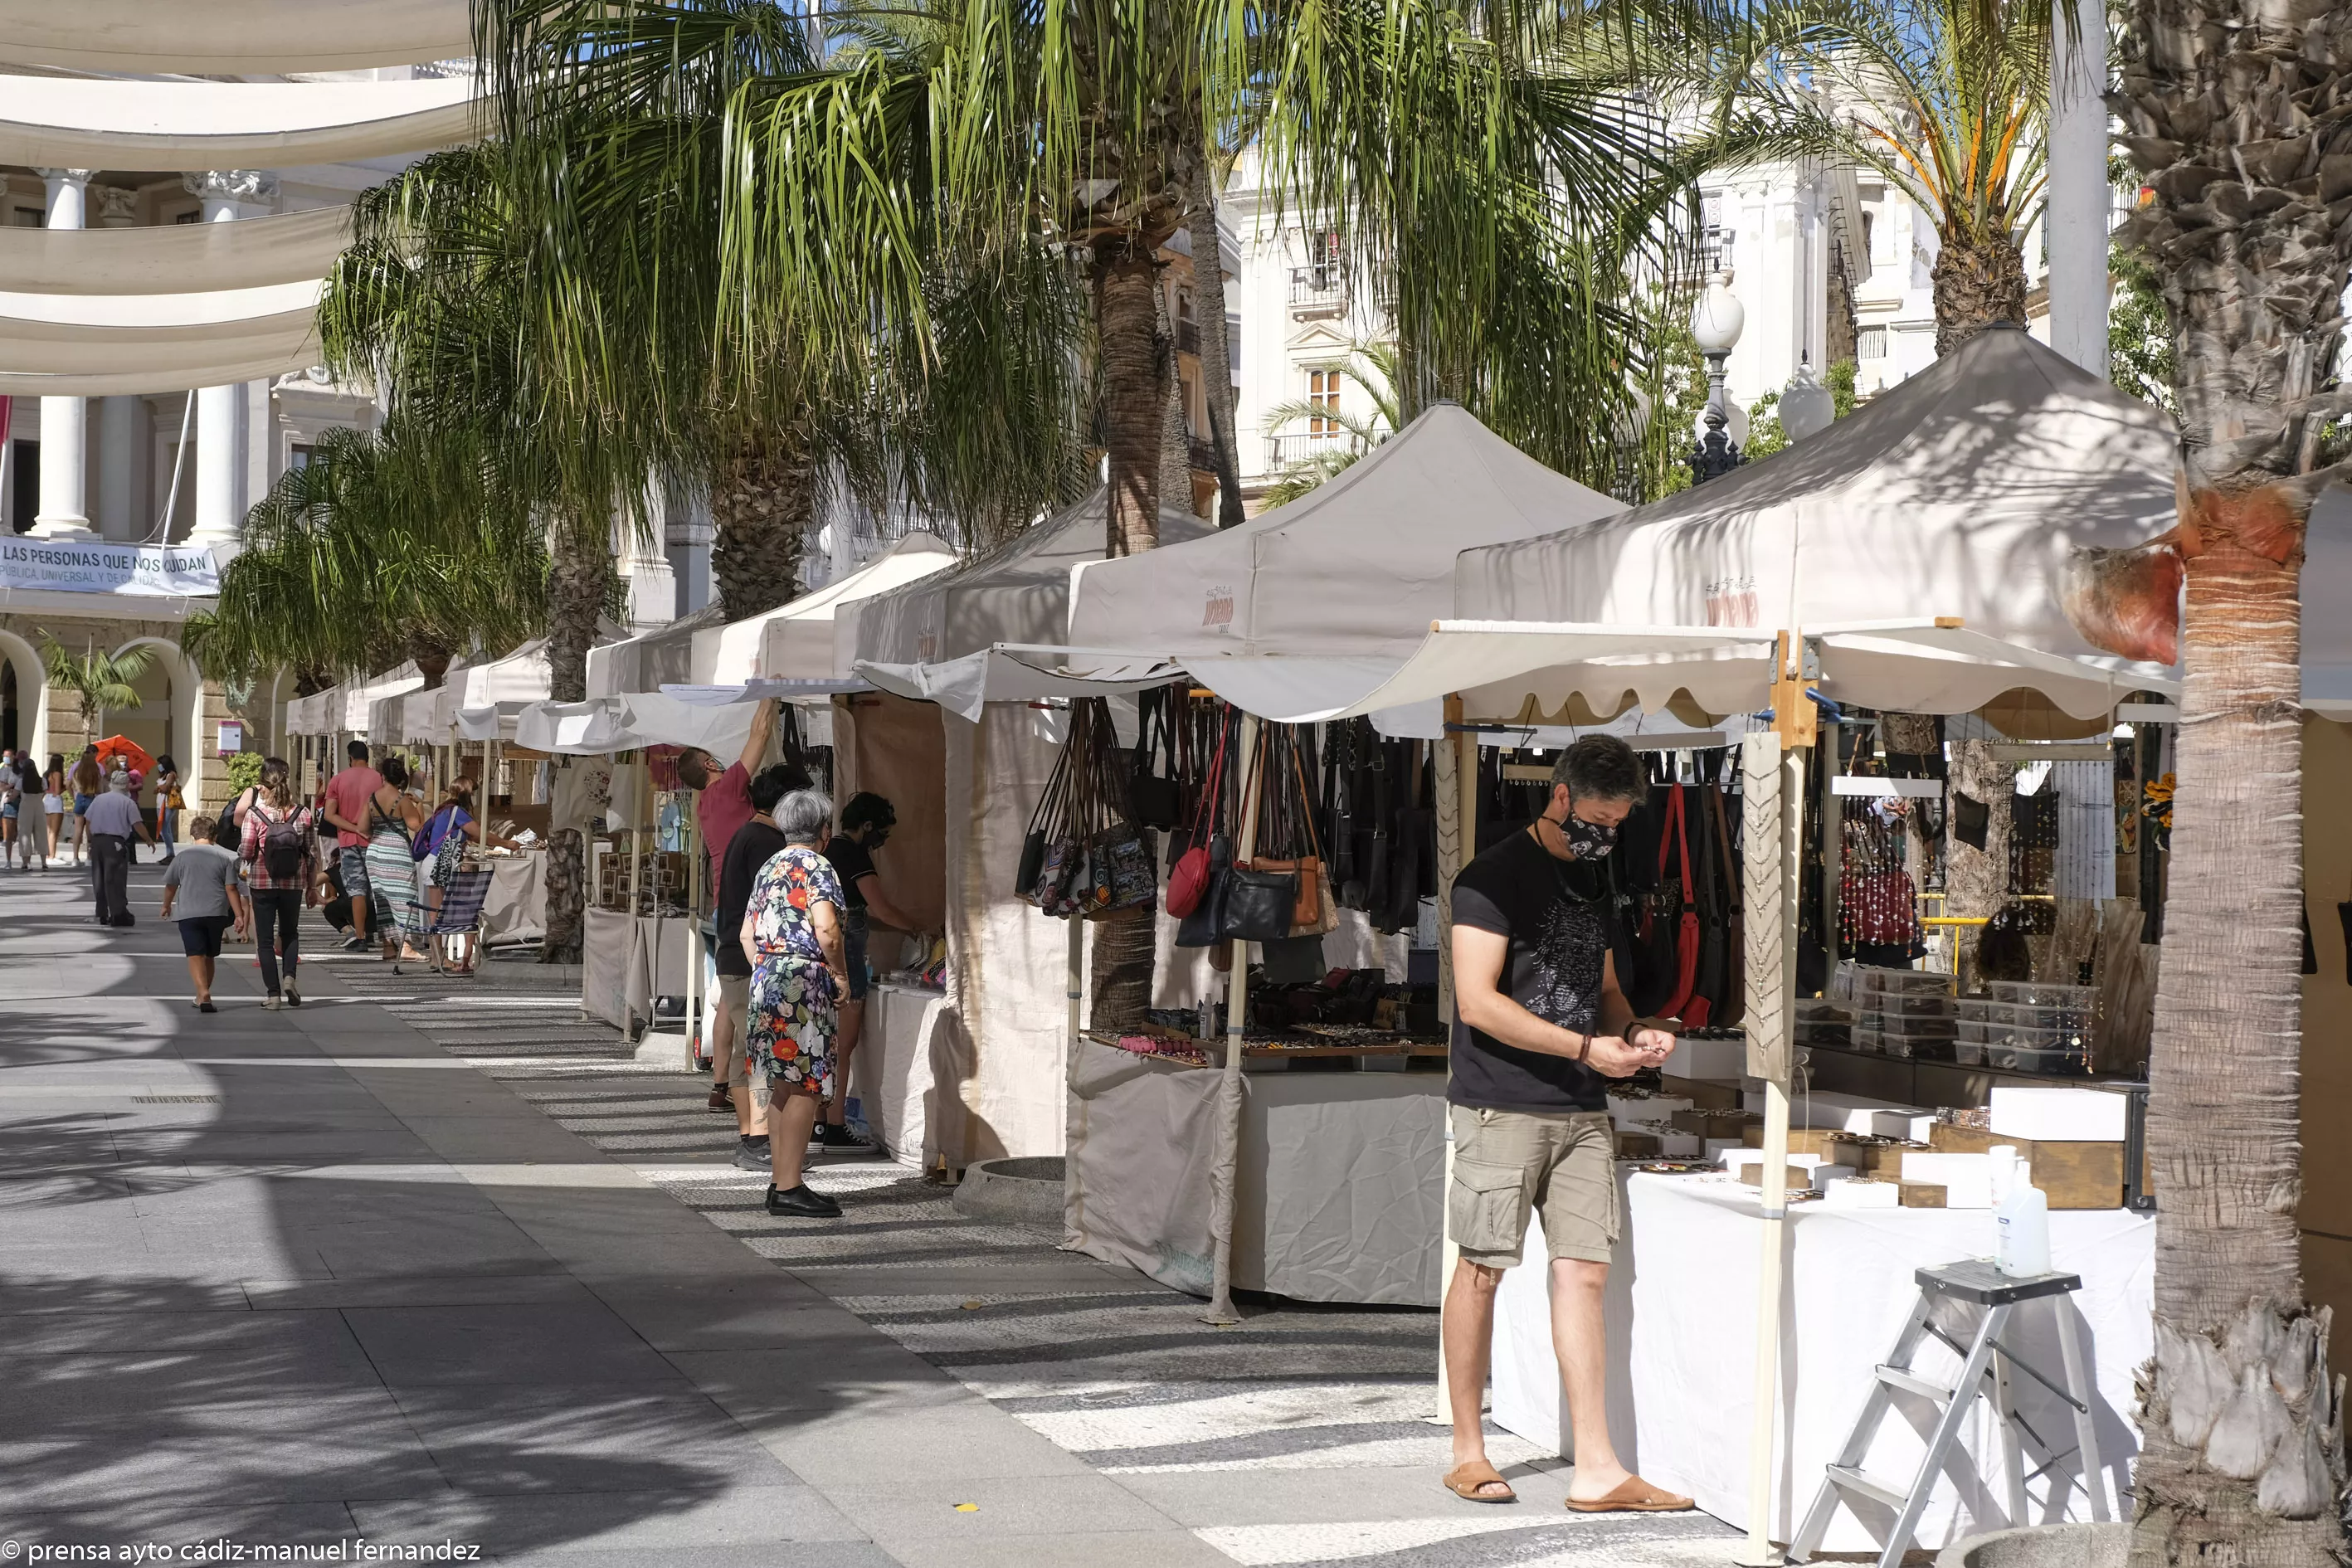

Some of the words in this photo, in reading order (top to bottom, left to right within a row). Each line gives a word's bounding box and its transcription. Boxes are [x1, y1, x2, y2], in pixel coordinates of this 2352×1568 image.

[3, 545, 28, 562] LAS
[30, 548, 100, 567] PERSONAS
[102, 554, 130, 570] QUE
[133, 556, 161, 572] NOS
[163, 556, 207, 572] CUIDAN
[41, 569, 96, 582] UNIVERSAL
[98, 572, 105, 582] Y
[106, 572, 120, 583] DE
